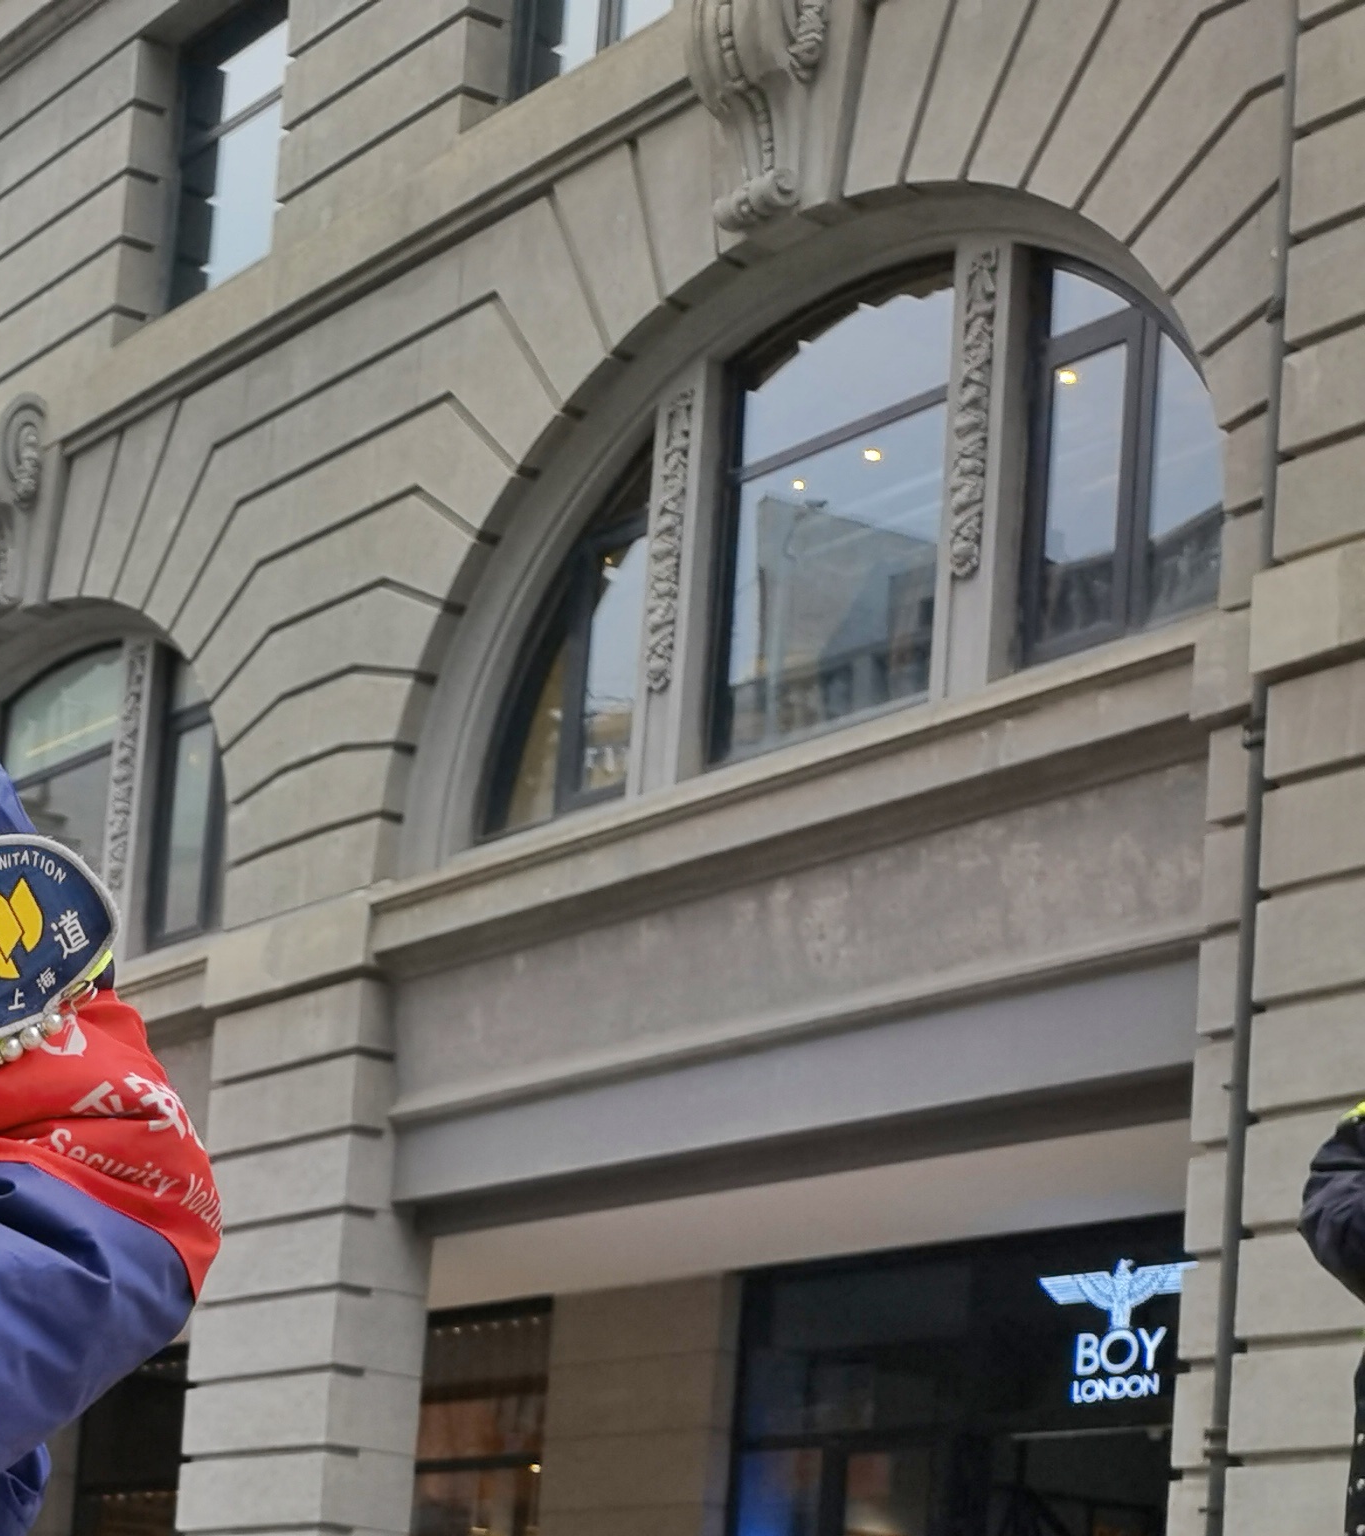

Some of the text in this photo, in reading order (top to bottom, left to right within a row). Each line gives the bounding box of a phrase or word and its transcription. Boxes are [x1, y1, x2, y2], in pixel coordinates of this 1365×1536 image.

[50, 1127, 179, 1198] Security
[1074, 1326, 1167, 1376] BOY
[1071, 1372, 1161, 1404] LONDON
